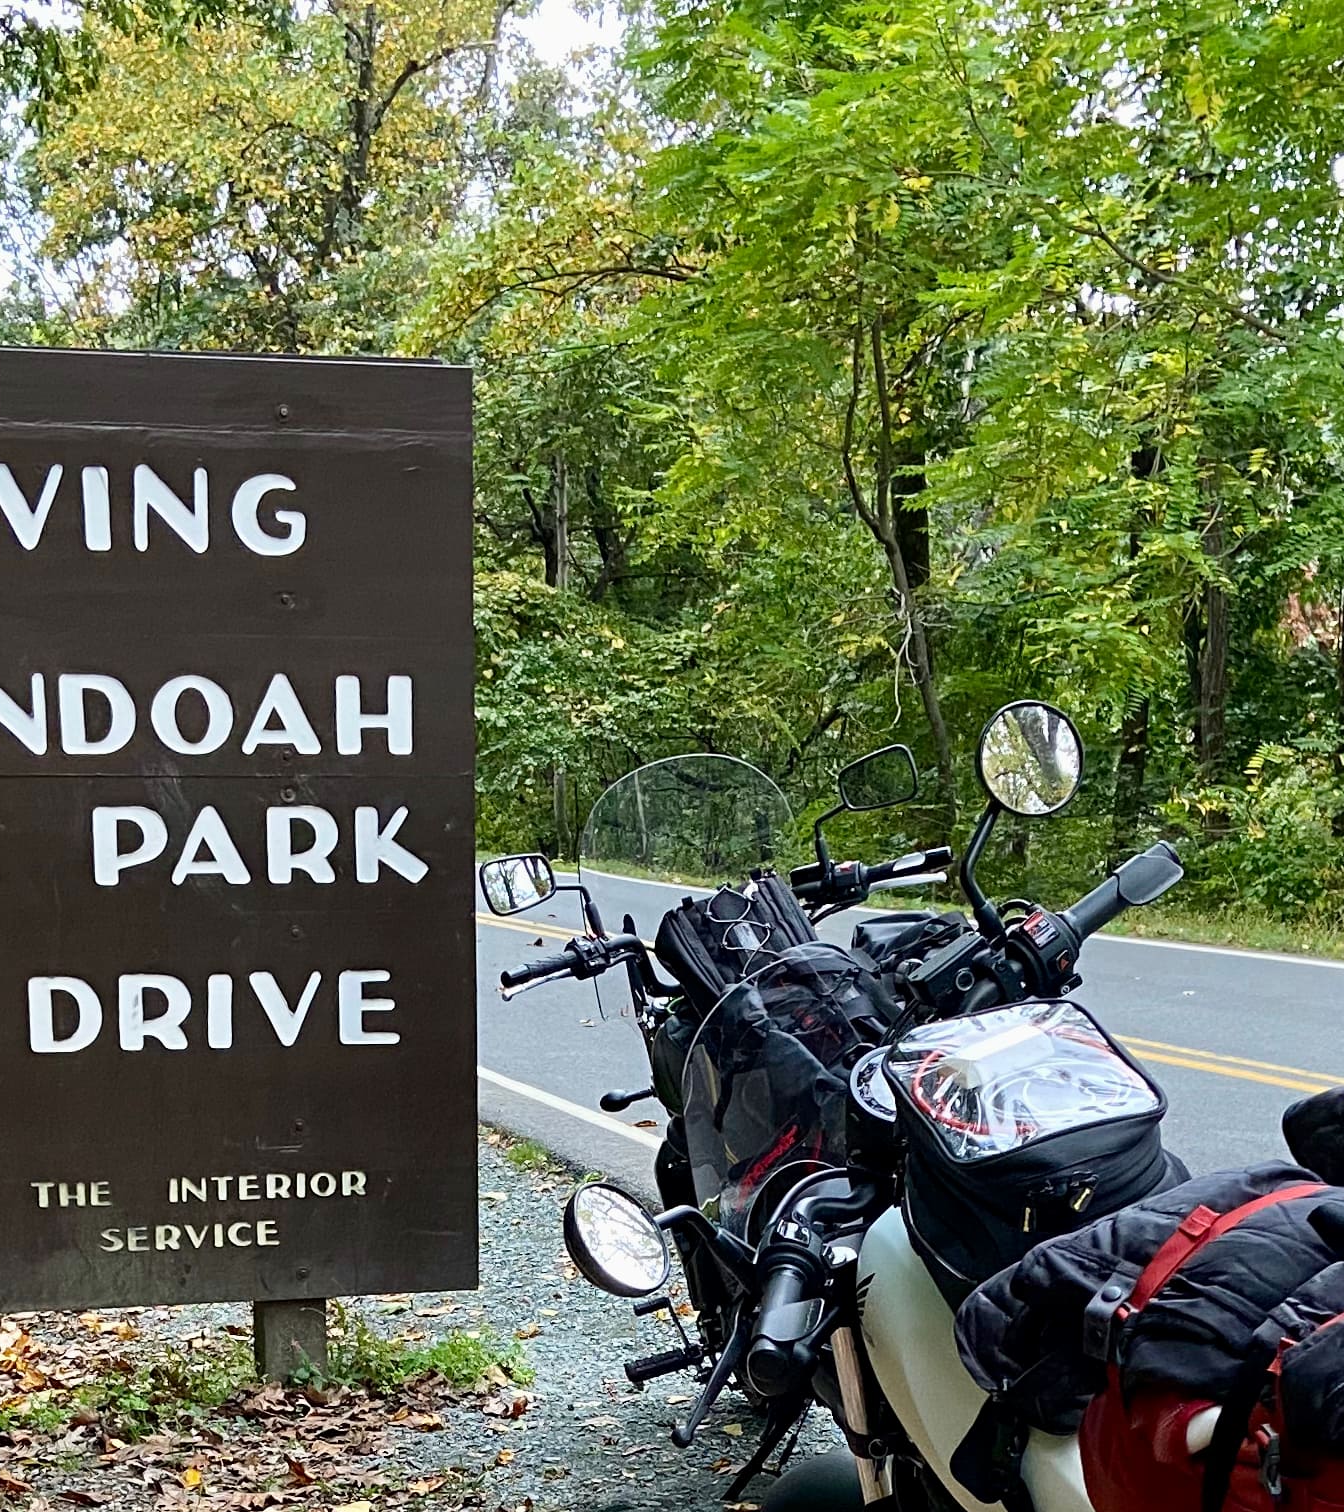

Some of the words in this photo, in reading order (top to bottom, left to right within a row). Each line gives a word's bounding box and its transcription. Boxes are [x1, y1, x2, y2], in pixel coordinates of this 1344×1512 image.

[92, 804, 429, 886] PARK
[27, 969, 401, 1053] DRIVE
[30, 1181, 112, 1208] THE
[169, 1170, 367, 1203] INTERIOR
[99, 1220, 280, 1252] SERVICE
